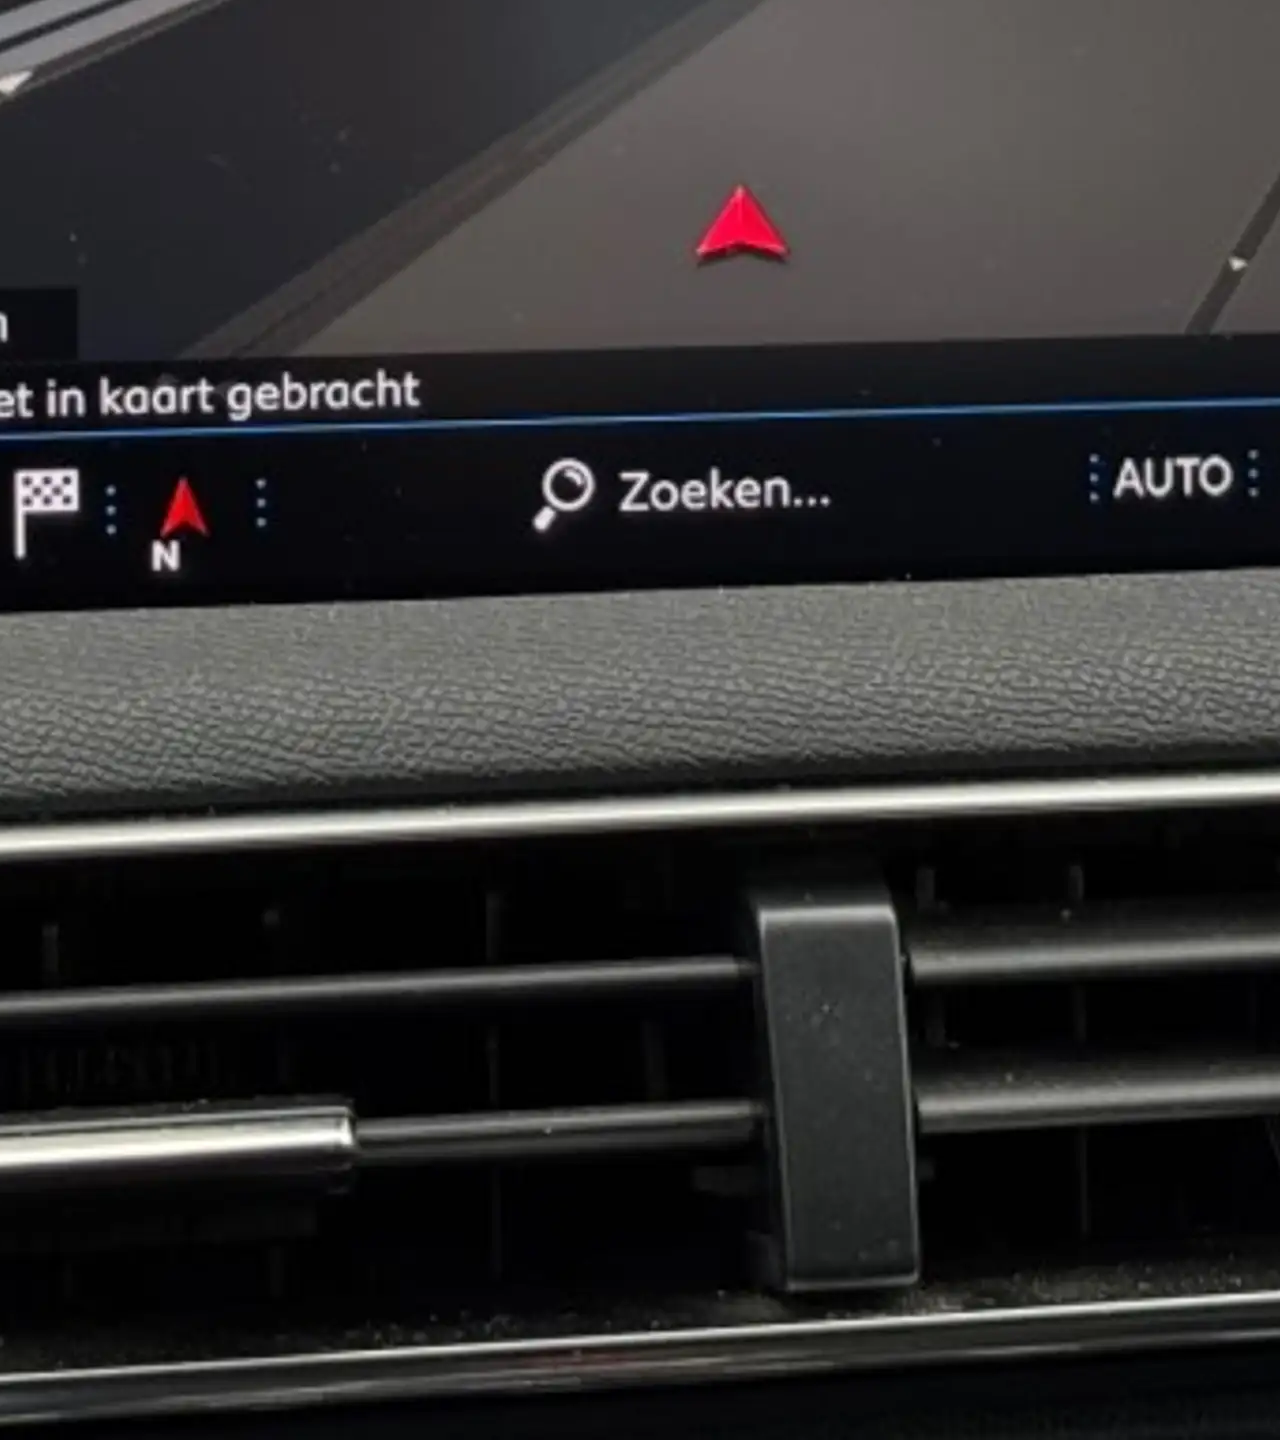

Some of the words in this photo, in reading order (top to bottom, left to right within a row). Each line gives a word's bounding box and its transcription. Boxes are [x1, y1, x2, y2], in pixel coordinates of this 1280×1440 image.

[47, 378, 86, 418] in
[100, 376, 216, 416] kaart
[226, 368, 421, 422] gebracht
[618, 466, 831, 513] Zoeken...
[1112, 453, 1234, 499] AUTO
[152, 539, 181, 571] N
